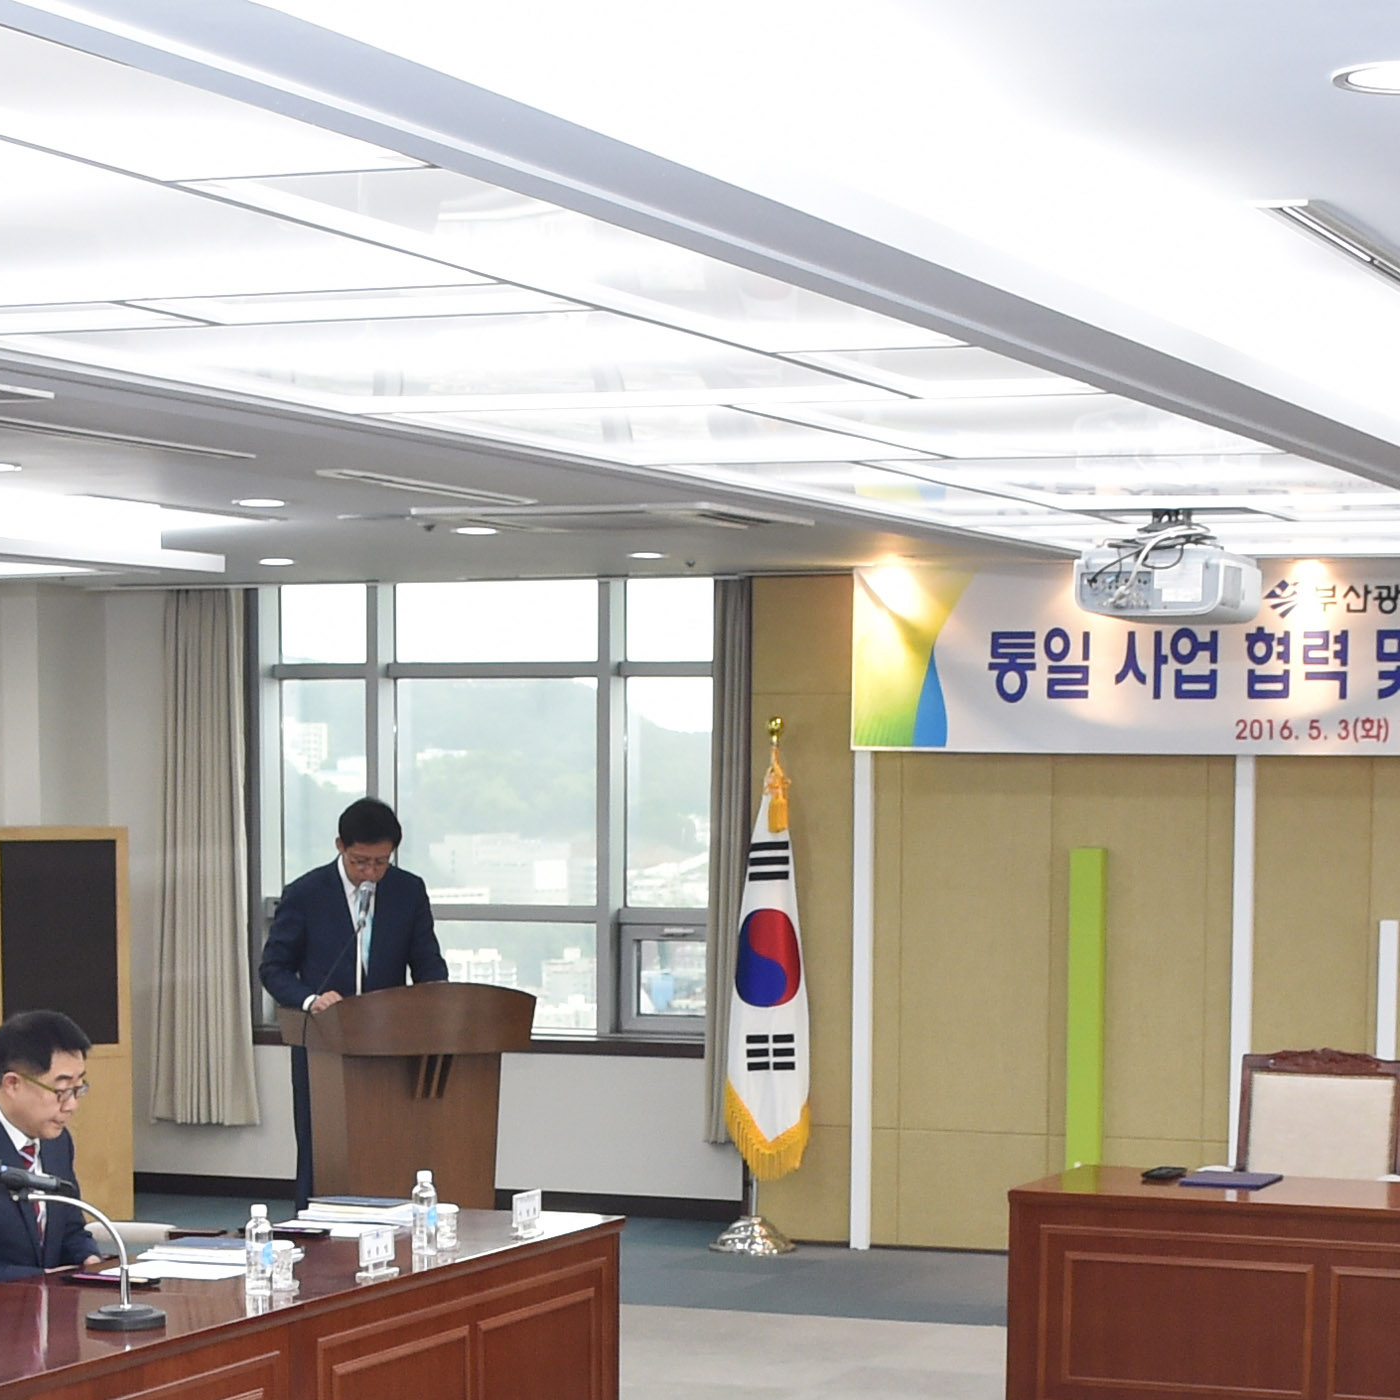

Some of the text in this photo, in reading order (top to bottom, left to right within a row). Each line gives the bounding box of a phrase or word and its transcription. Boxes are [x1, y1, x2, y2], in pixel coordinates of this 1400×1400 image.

[987, 626, 1091, 704] 통일
[1114, 626, 1221, 701] 사업
[1244, 626, 1349, 701] 협력
[1235, 718, 1300, 742] 2016.
[1308, 718, 1330, 742] 5.
[1336, 716, 1391, 744] 3(화)
